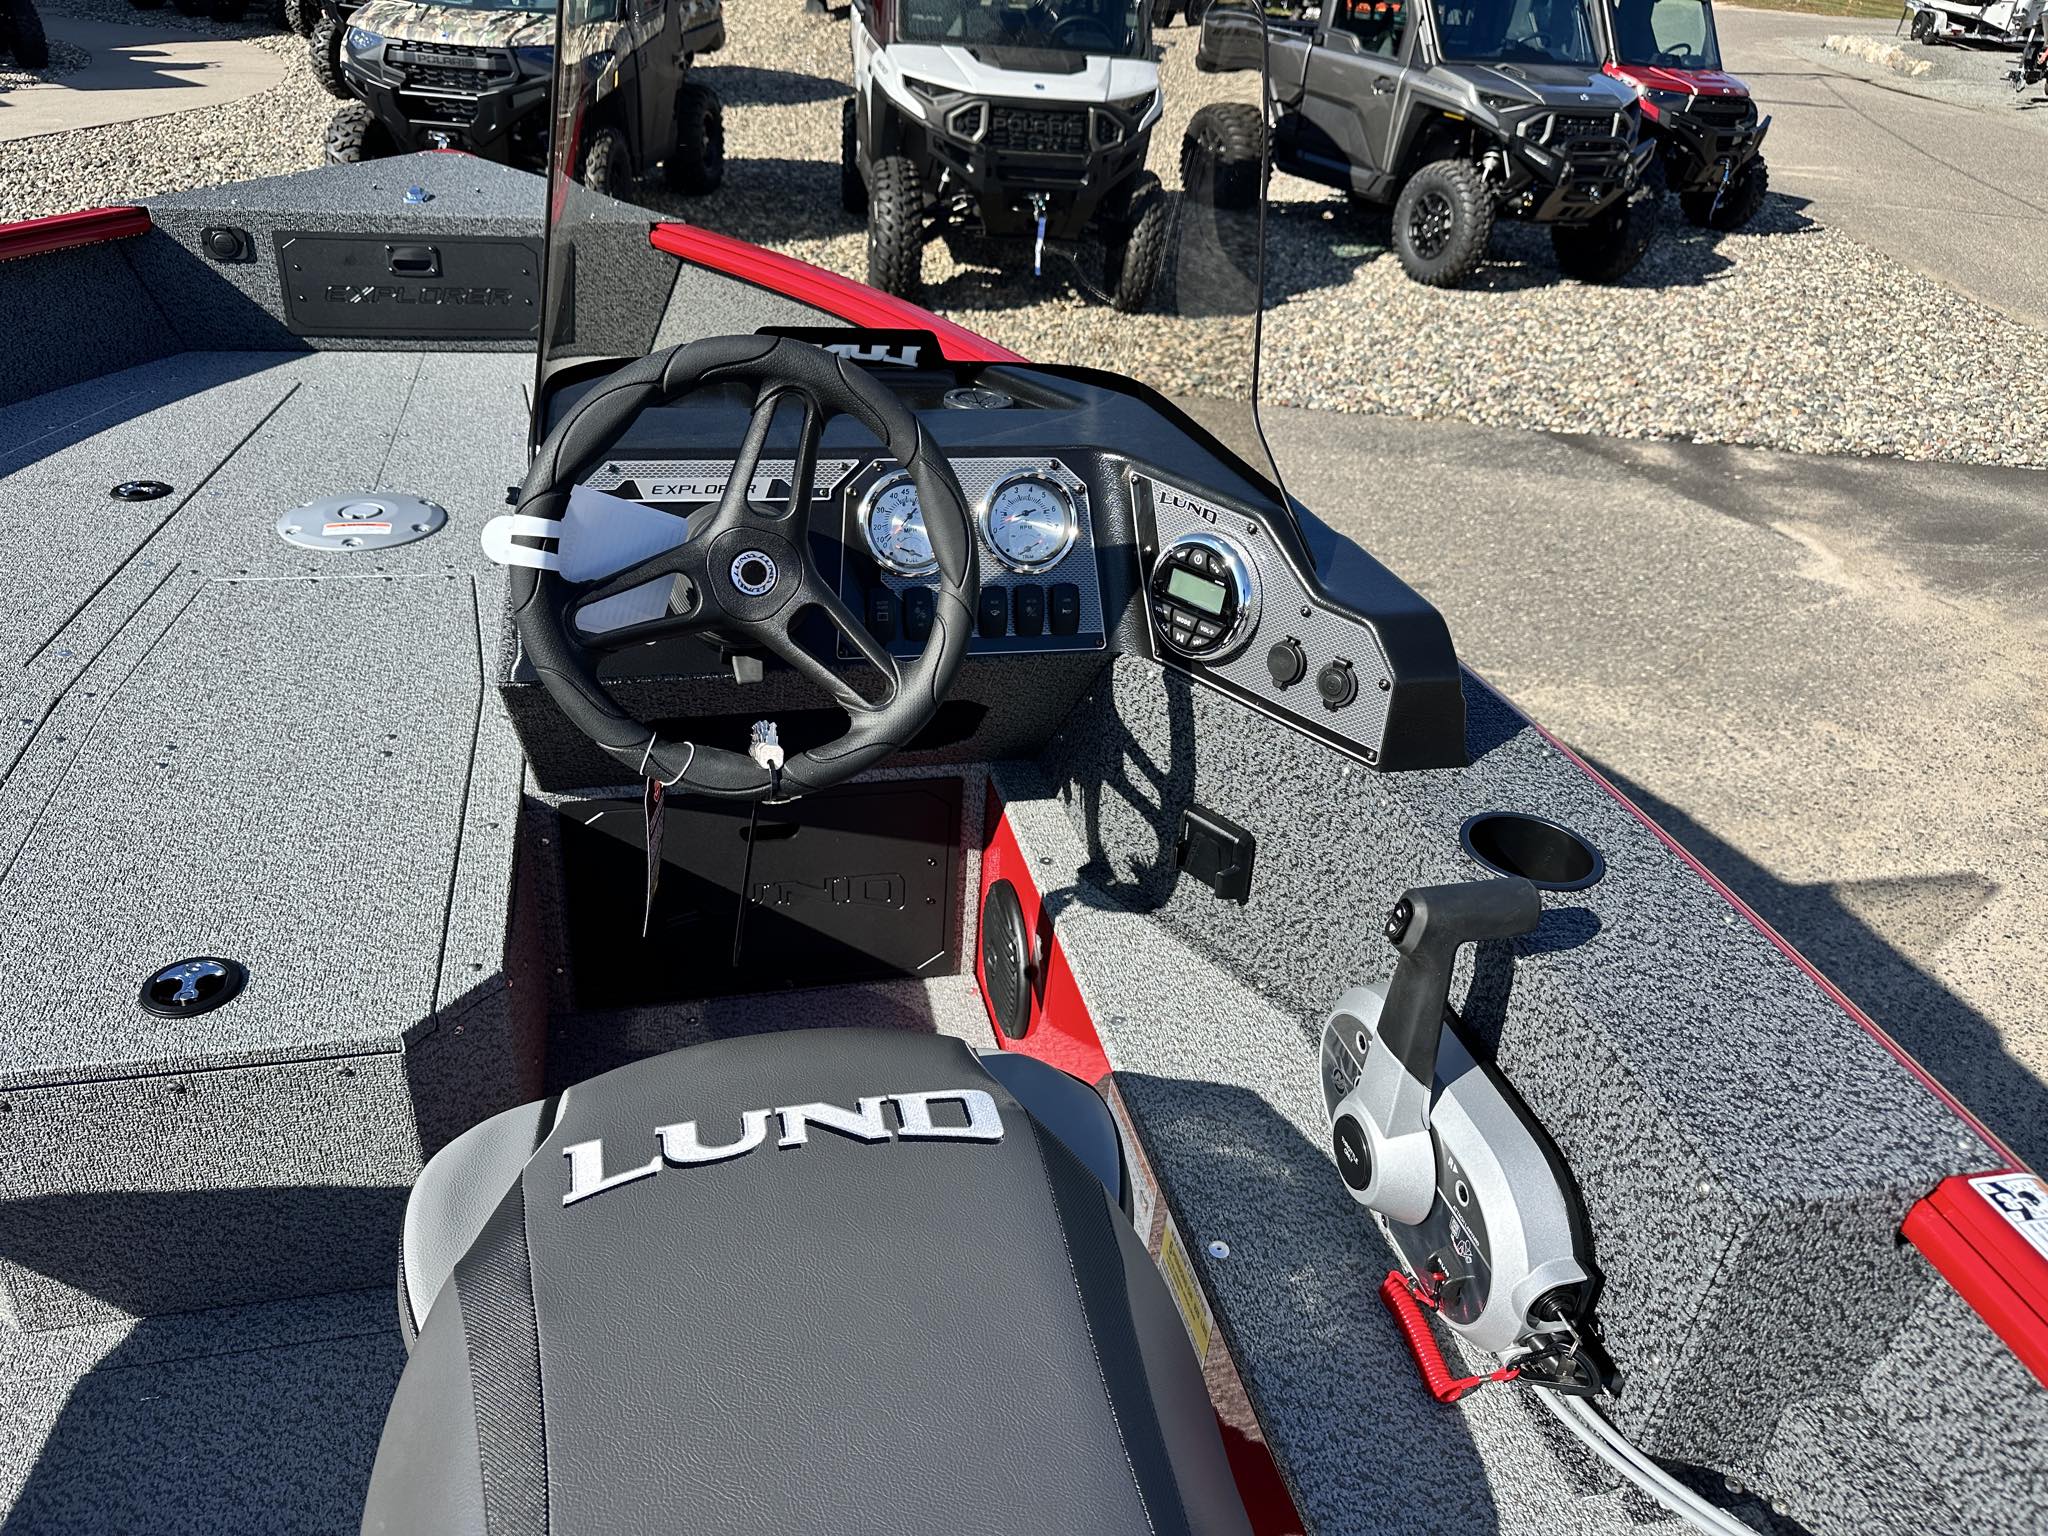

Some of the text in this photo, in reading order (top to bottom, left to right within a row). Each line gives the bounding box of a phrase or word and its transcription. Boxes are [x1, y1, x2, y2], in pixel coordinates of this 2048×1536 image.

[416, 53, 477, 67] POLARIS
[993, 117, 1083, 135] POLARIS
[325, 285, 513, 304] EXPLORER
[1014, 486, 1019, 494] 3
[889, 492, 899, 500] 40
[1002, 493, 1007, 501] 2
[876, 506, 885, 514] 30
[1159, 491, 1218, 525] LUND
[873, 523, 882, 531] 20
[876, 536, 885, 544] 10
[1176, 615, 1191, 627] MODE
[562, 1089, 1005, 1206] LUND
